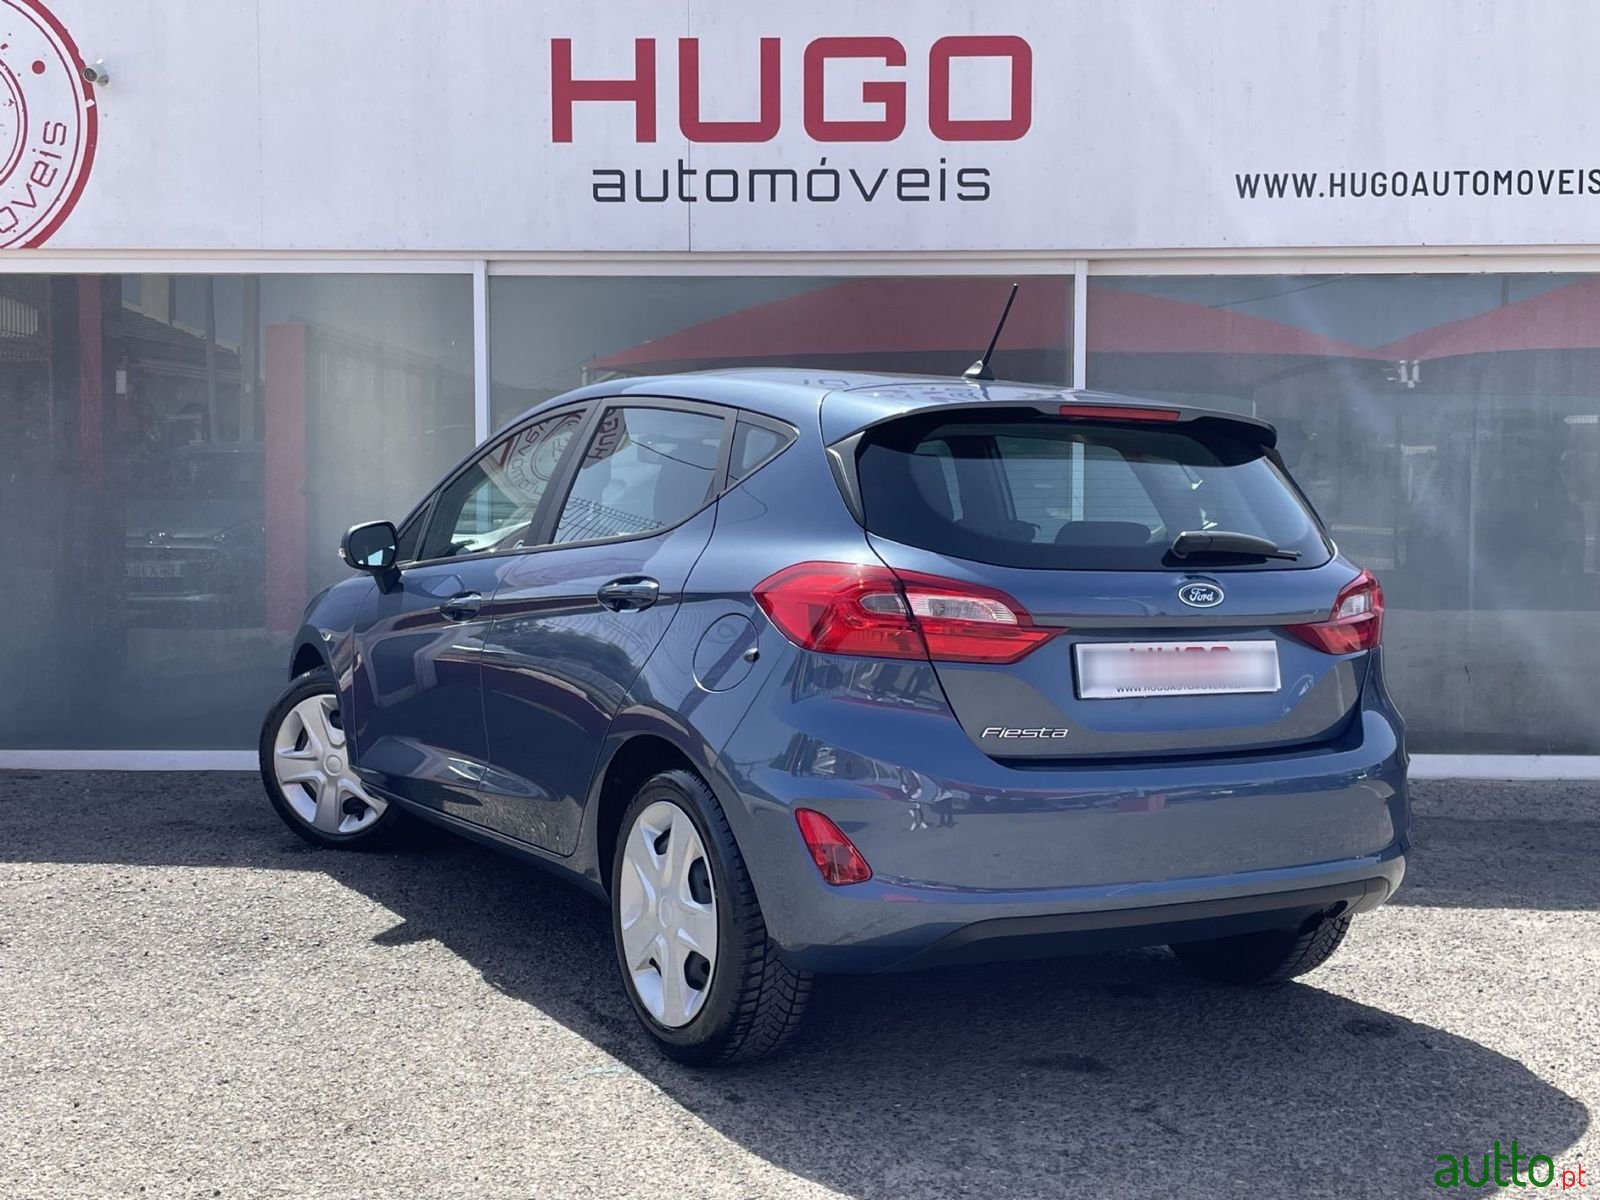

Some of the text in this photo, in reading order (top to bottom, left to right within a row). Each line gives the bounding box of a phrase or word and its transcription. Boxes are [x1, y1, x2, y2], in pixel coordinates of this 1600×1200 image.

[551, 35, 1033, 143] HUGO
[592, 156, 991, 203] automóveis
[1235, 168, 1600, 199] WWW.HUGOAUTOMOVEIS
[1189, 587, 1214, 602] Ford
[980, 726, 1070, 739] Fiesta
